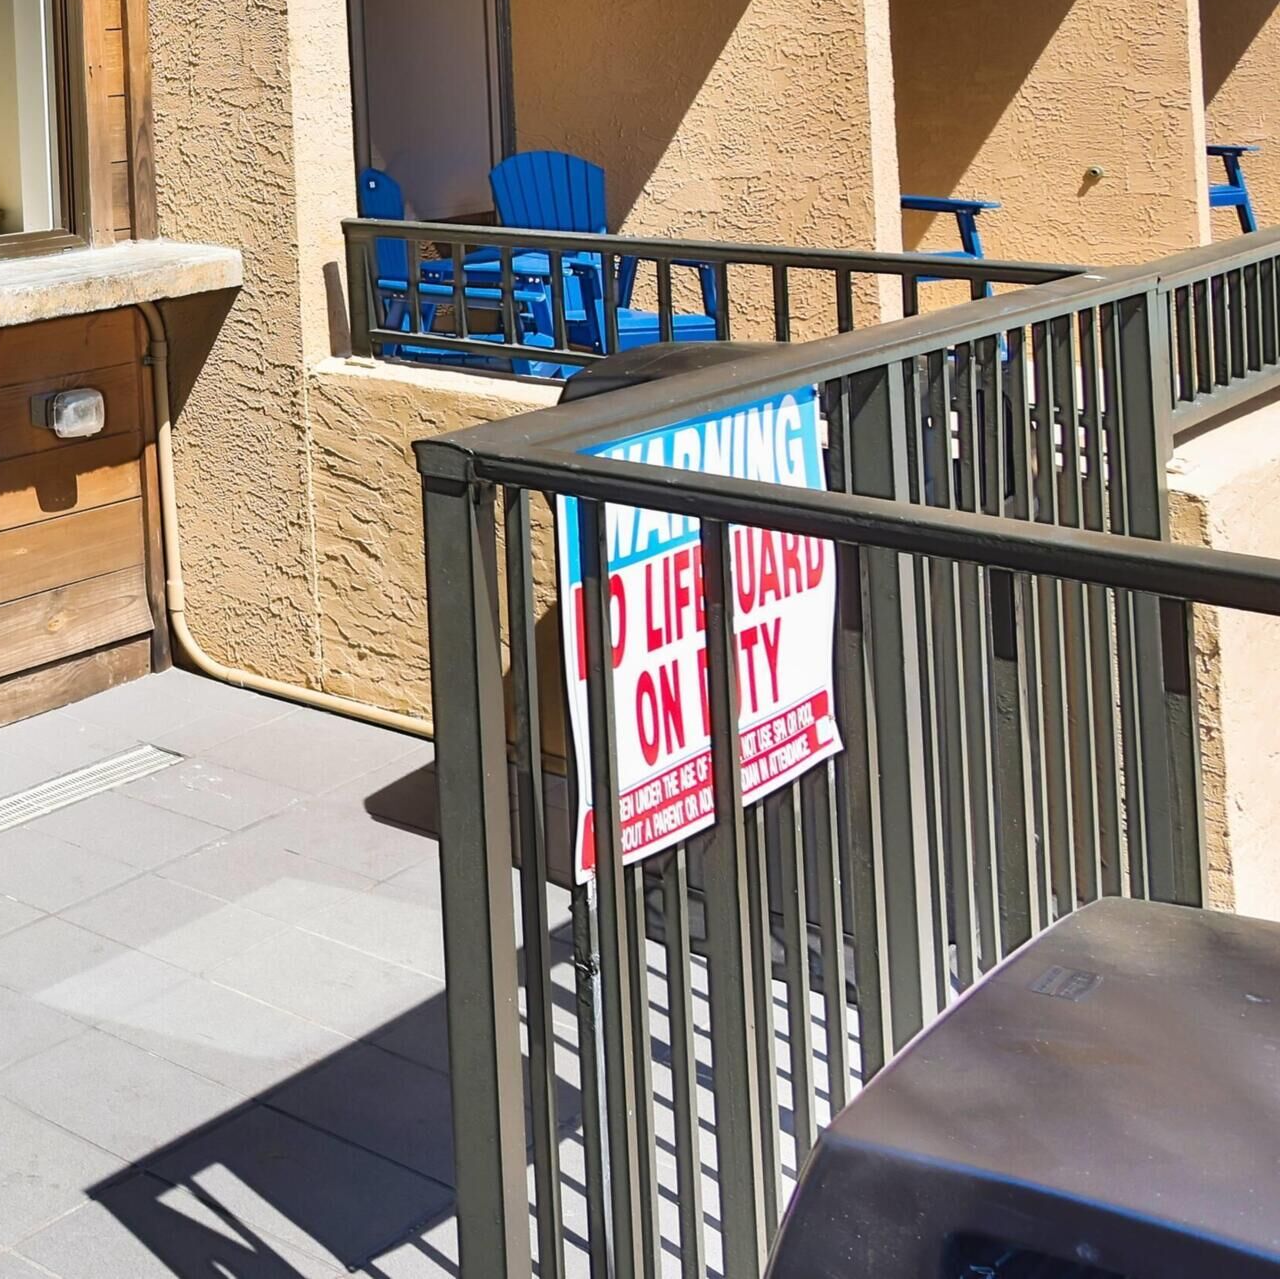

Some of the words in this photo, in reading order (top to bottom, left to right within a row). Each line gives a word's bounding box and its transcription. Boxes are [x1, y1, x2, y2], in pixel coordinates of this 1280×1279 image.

[645, 527, 825, 653] LIFEUARD
[634, 779, 663, 815] UNDER
[661, 770, 681, 800] THE
[680, 761, 698, 791] AGE
[696, 754, 709, 782] OF
[755, 722, 774, 753] USE
[772, 716, 789, 744] SPA
[796, 701, 816, 730] POOL
[635, 658, 686, 767] ON
[644, 817, 654, 842] A
[652, 800, 685, 838] PARENT
[684, 793, 700, 821] OR
